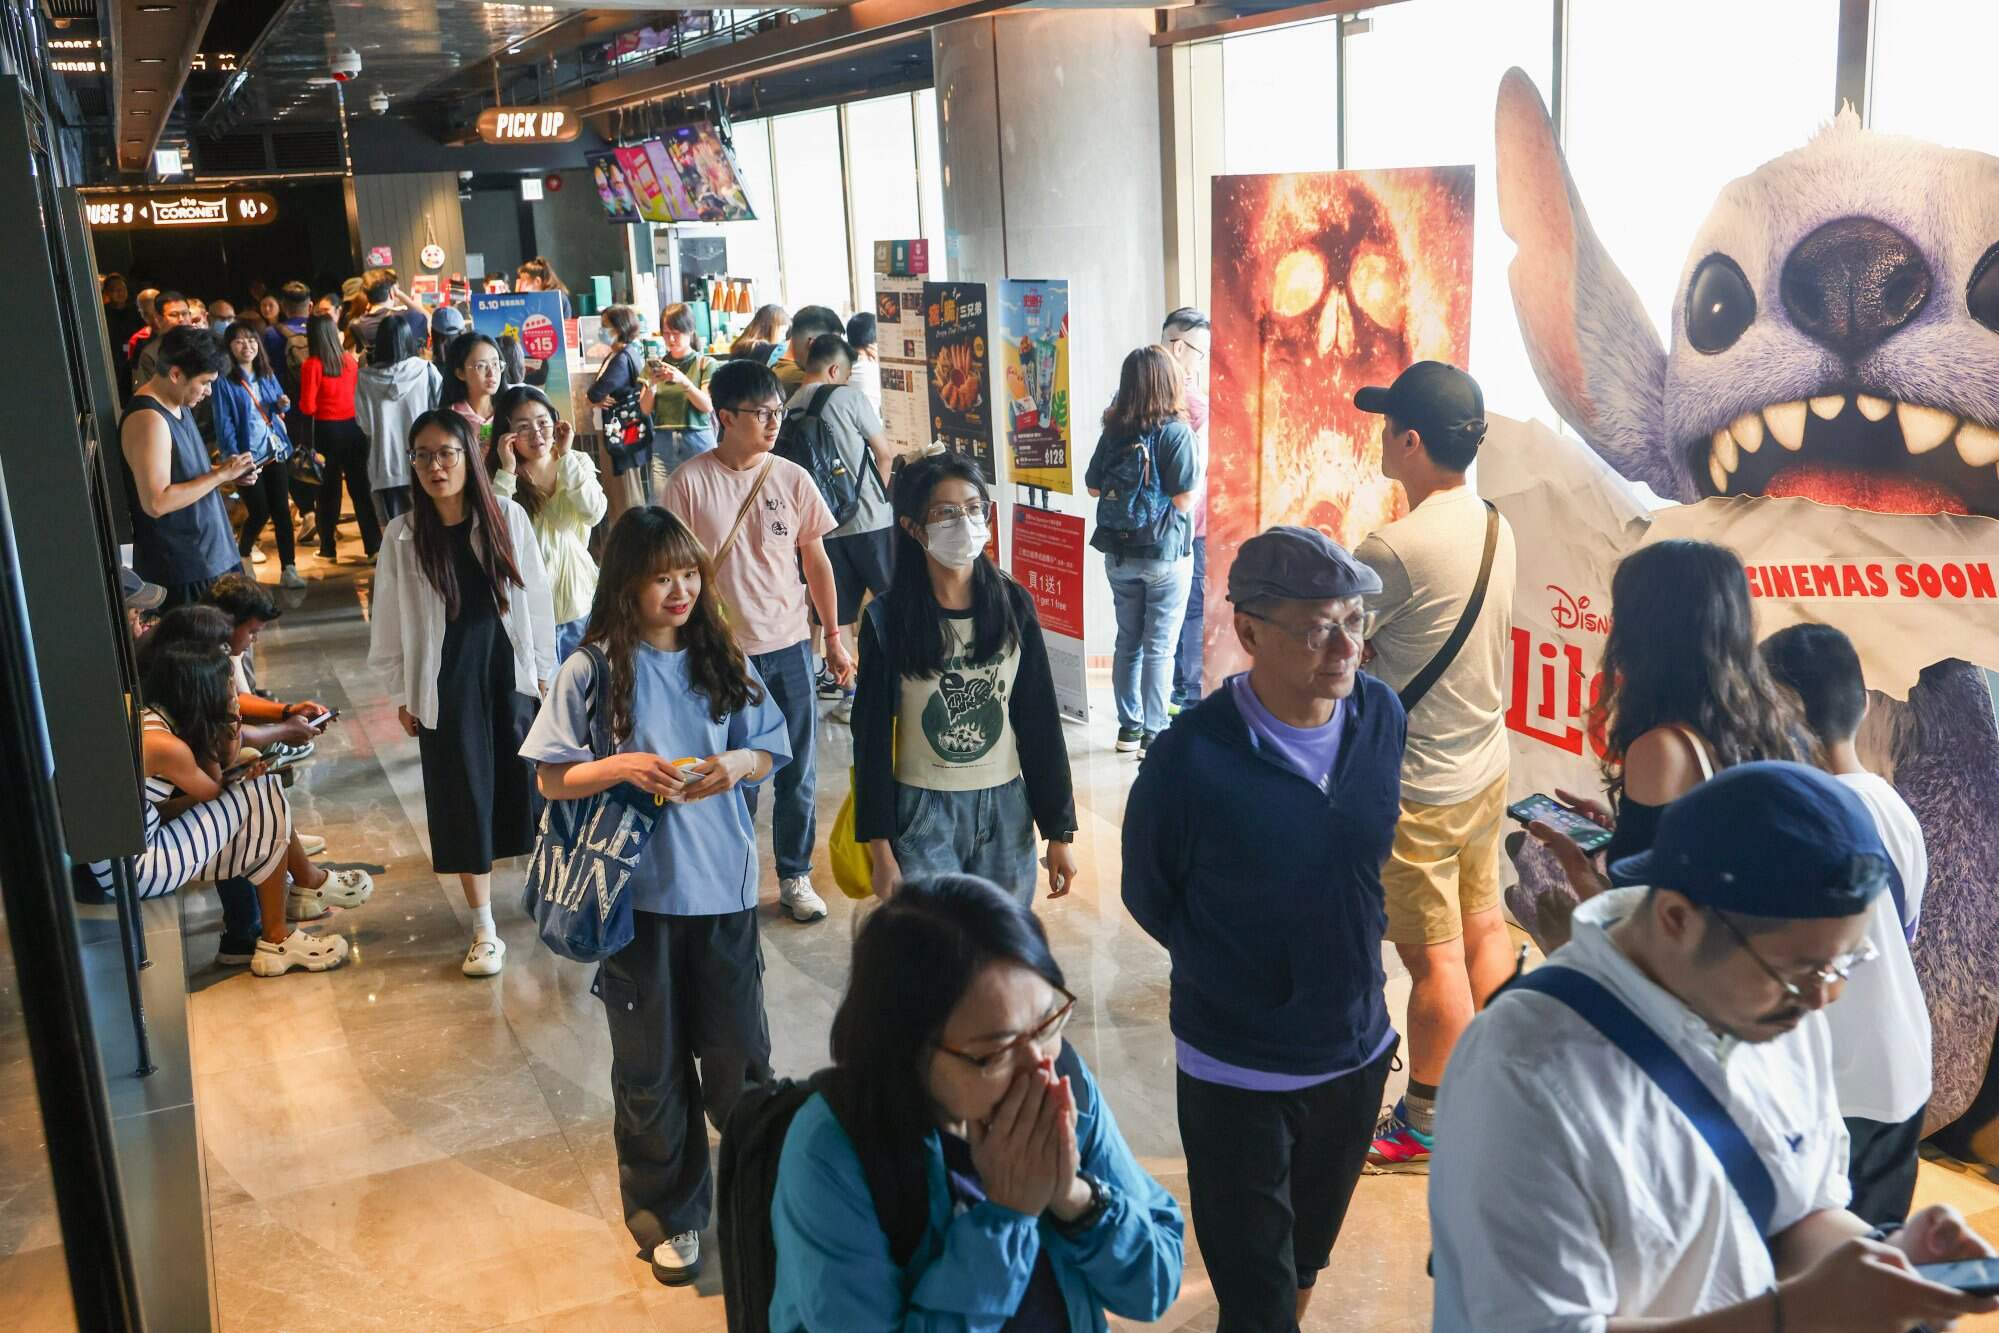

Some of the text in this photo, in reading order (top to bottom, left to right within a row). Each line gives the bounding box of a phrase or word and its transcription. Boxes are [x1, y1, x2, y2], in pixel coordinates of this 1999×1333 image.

[496, 111, 564, 138] PICK UP
[123, 203, 134, 223] 3
[159, 206, 220, 219] CORONET
[180, 196, 197, 207] the
[1044, 448, 1065, 466] $128
[1028, 570, 1061, 596] 買1送1
[1744, 562, 1998, 599] CINEMAS SOON
[1546, 585, 1613, 635] Disn
